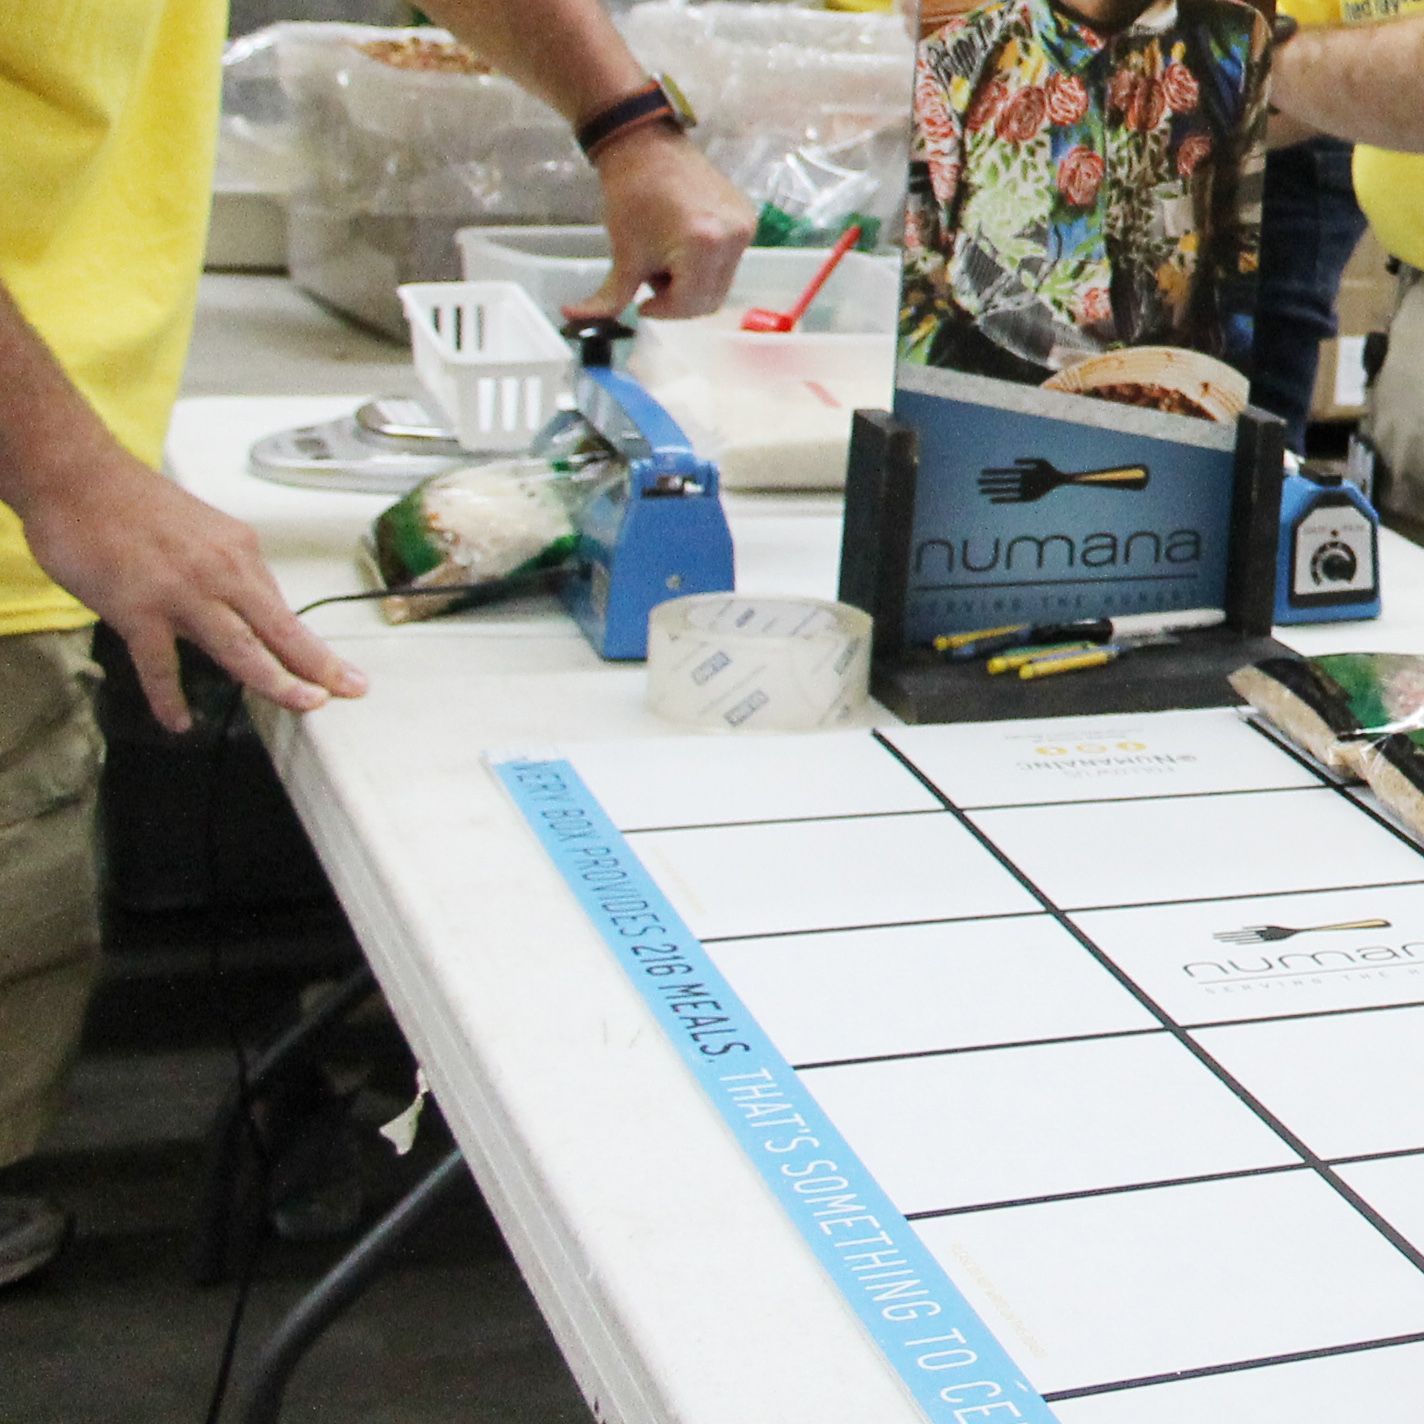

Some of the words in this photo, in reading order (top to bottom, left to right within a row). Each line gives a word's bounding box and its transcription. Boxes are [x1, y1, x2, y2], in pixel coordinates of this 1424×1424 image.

[915, 528, 1202, 574] numana
[541, 808, 600, 844] BOX
[566, 846, 667, 939] PROVIDES
[631, 943, 694, 978] 216
[1341, 969, 1392, 984] THE
[658, 982, 750, 1063] MEALS.
[719, 1067, 820, 1153] THAT'S
[781, 1160, 942, 1322] SOMETHING
[905, 1328, 978, 1372] TO
